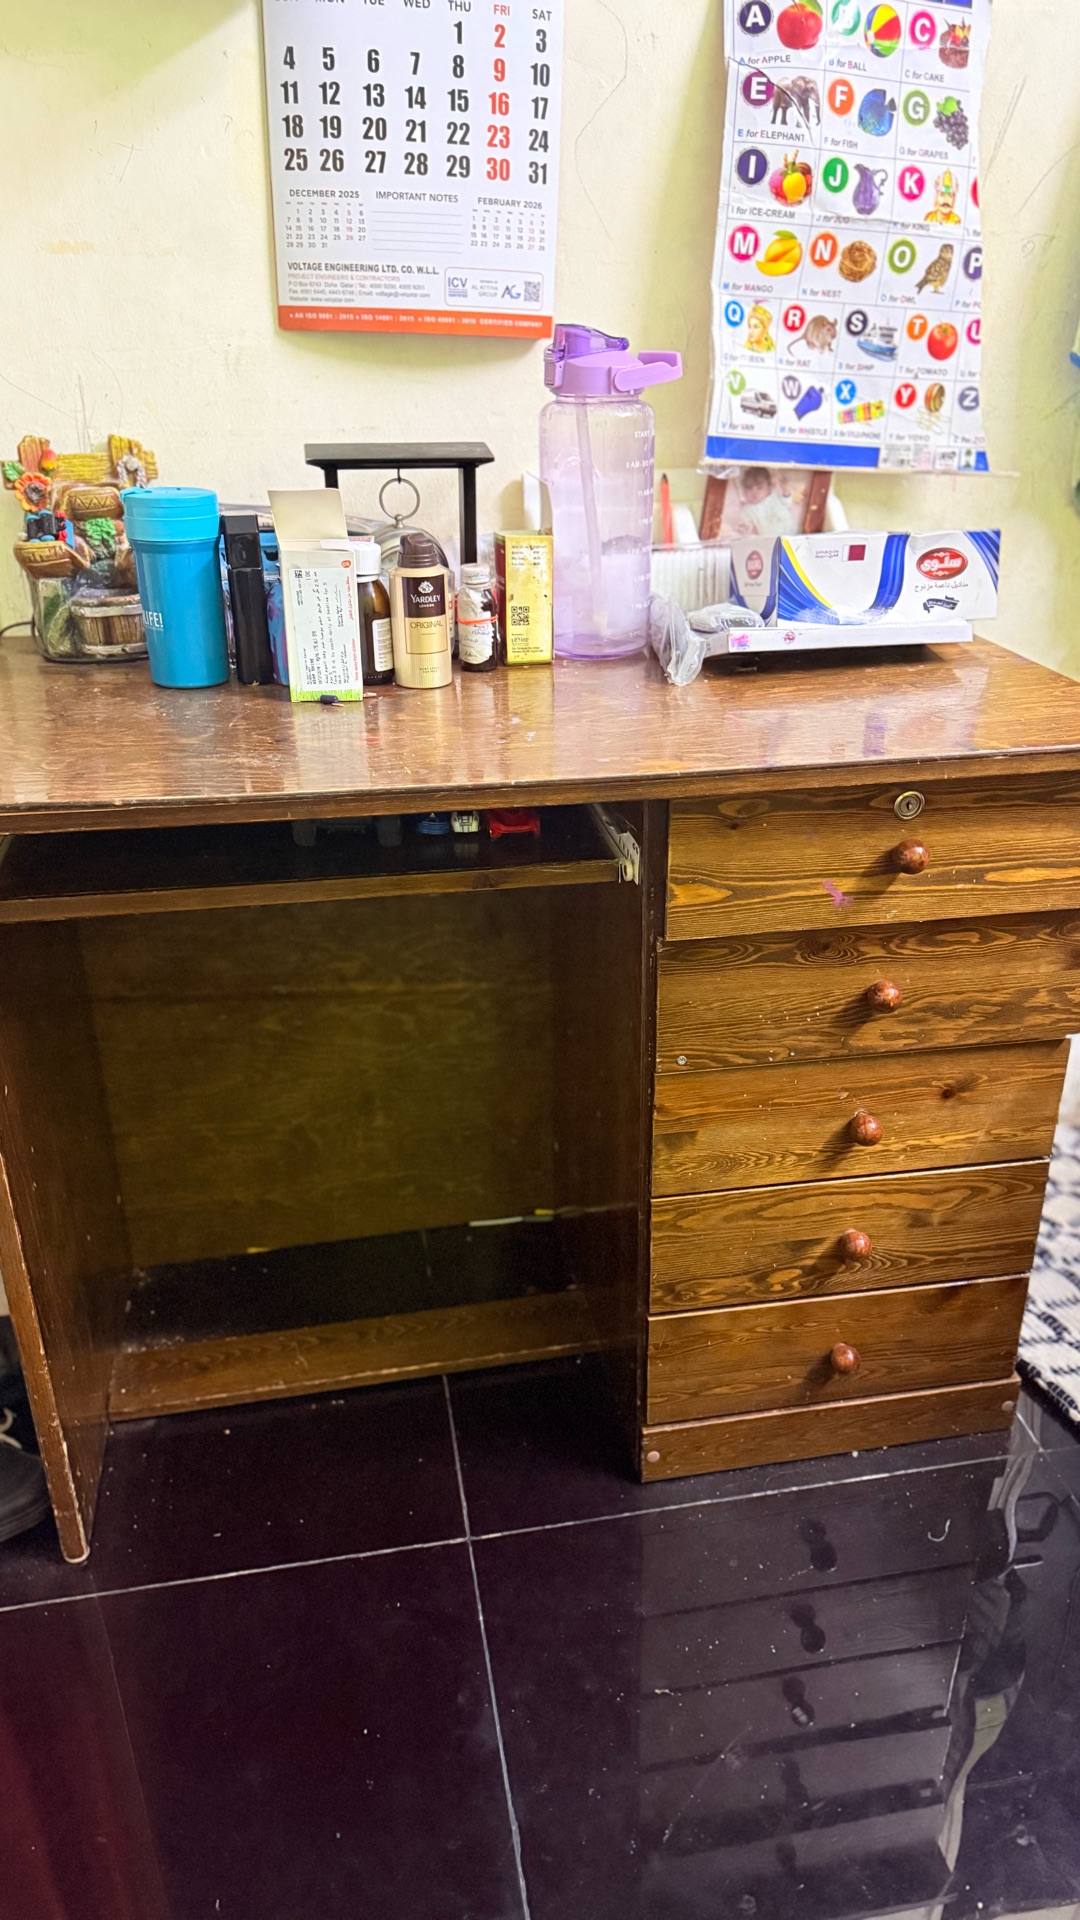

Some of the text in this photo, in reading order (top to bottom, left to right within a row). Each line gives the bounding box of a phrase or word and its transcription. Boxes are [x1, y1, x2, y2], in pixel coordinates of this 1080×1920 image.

[448, 1, 471, 12] THU
[494, 4, 510, 15] FRI
[532, 8, 552, 20] SAT
[745, 5, 765, 28] A
[454, 21, 546, 52] 1 2 3
[915, 18, 931, 42] C
[284, 46, 550, 86] 4 5 6 7 8 9 10
[748, 56, 760, 64] for
[761, 55, 791, 64] APPLE
[836, 60, 846, 68] for
[848, 61, 867, 71] BALL
[912, 71, 922, 79] for
[924, 72, 944, 82] CAKE
[750, 76, 768, 101] E
[835, 86, 848, 108] F
[280, 81, 548, 119] 11 12 13 14 15 16 17
[908, 96, 925, 120] G
[282, 115, 548, 152] 18 19 20 21 22 23 24
[737, 128, 805, 142] E for ELEPHANT
[830, 138, 841, 146] for
[842, 139, 858, 149] FISH
[907, 148, 949, 159] for GRAPES
[284, 148, 547, 184] 25 26 27 28 29 30 31
[748, 155, 757, 178] I
[829, 164, 842, 187] J
[903, 172, 920, 195] K
[289, 189, 360, 198] DECEMBER 2025
[375, 191, 459, 203] IMPORTANT NOTES
[477, 197, 543, 209] FEBRUARY 2026
[736, 207, 748, 215] for
[749, 207, 796, 219] ICE-CREAM
[733, 232, 755, 255] M
[815, 240, 833, 261] N
[893, 246, 911, 267] O
[968, 254, 982, 274] P
[287, 262, 440, 275] VOLTAGE ENGINEERING LTD. CO. W.L.L.
[448, 277, 468, 288] ICV
[731, 283, 742, 291] for
[744, 283, 773, 293] MANGO
[821, 289, 842, 298] NEST
[727, 305, 741, 323] Q
[788, 311, 801, 329] R
[850, 314, 864, 332] S
[912, 319, 923, 337] T
[728, 373, 743, 392] V
[783, 380, 800, 398] W
[840, 383, 852, 401] X
[899, 386, 914, 403] Y
[962, 390, 979, 407] Z
[920, 556, 962, 572] سلوى
[410, 594, 440, 604] YARDLEY
[145, 611, 163, 628] LIFE!
[410, 620, 444, 629] ORIGINAL
